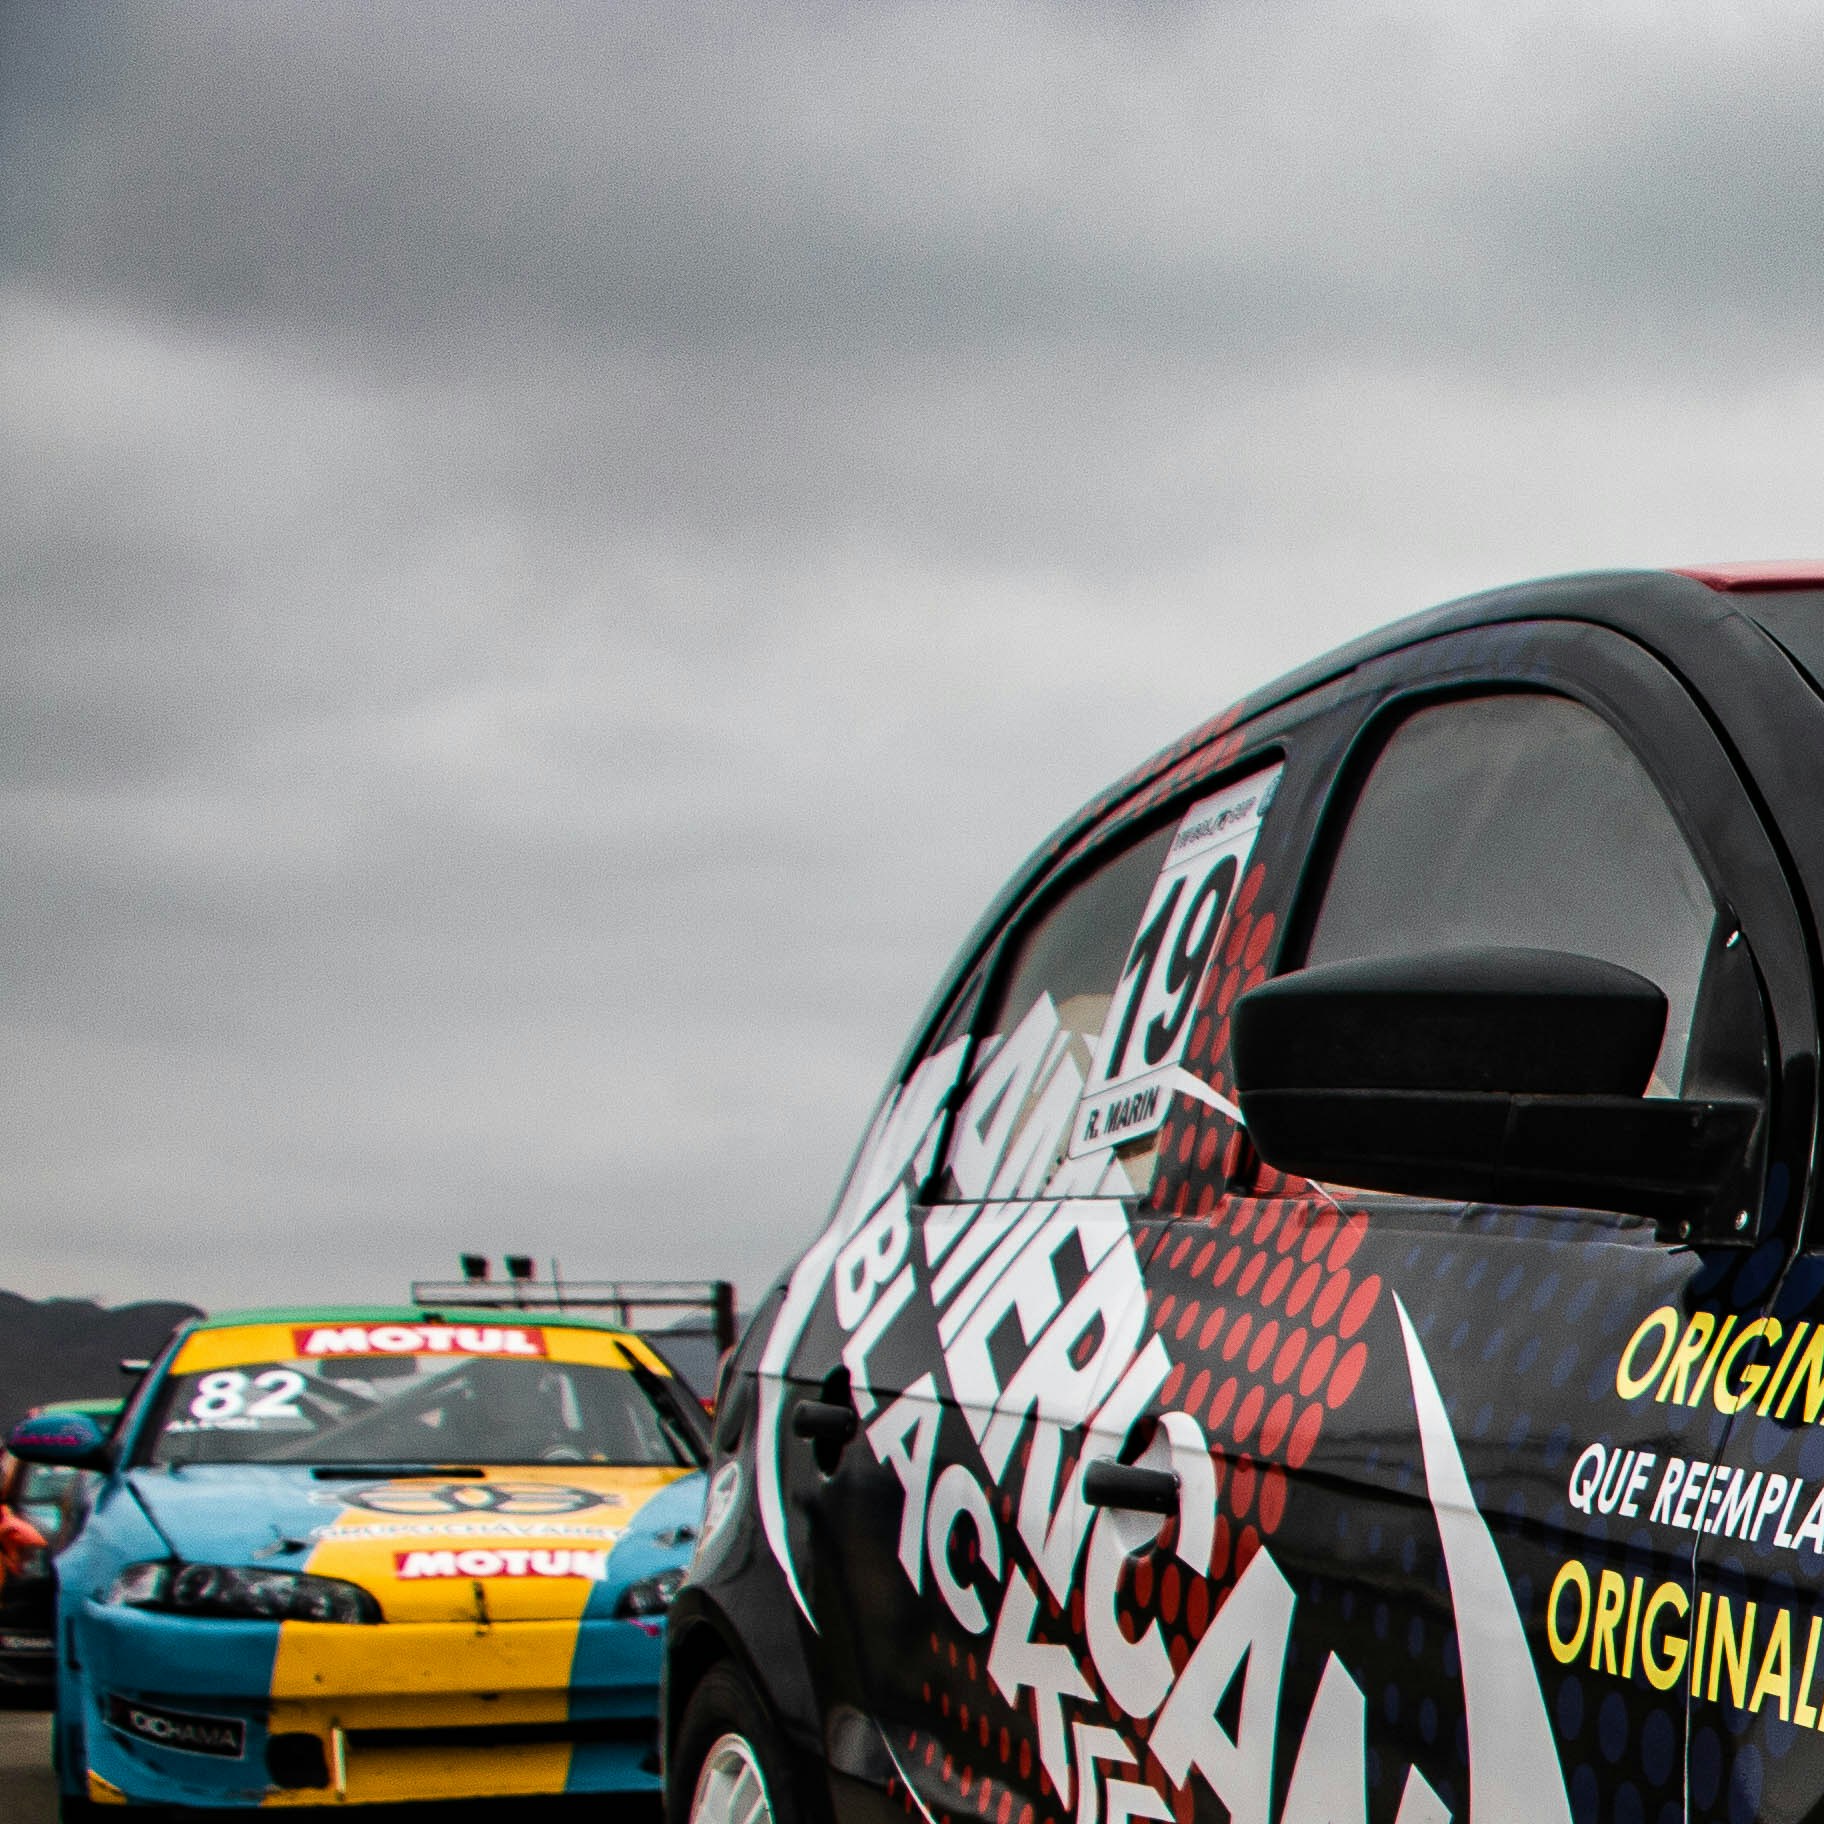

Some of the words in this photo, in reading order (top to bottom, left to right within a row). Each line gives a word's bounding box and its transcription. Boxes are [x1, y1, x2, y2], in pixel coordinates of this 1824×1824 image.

[1105, 854, 1238, 1081] 19
[1082, 1109, 1102, 1142] R.
[1103, 1086, 1160, 1135] MARIN
[305, 1326, 540, 1355] MOTUL
[189, 1370, 307, 1419] 82
[836, 1182, 1100, 1812] BLACK
[1568, 1442, 1656, 1519] QUE
